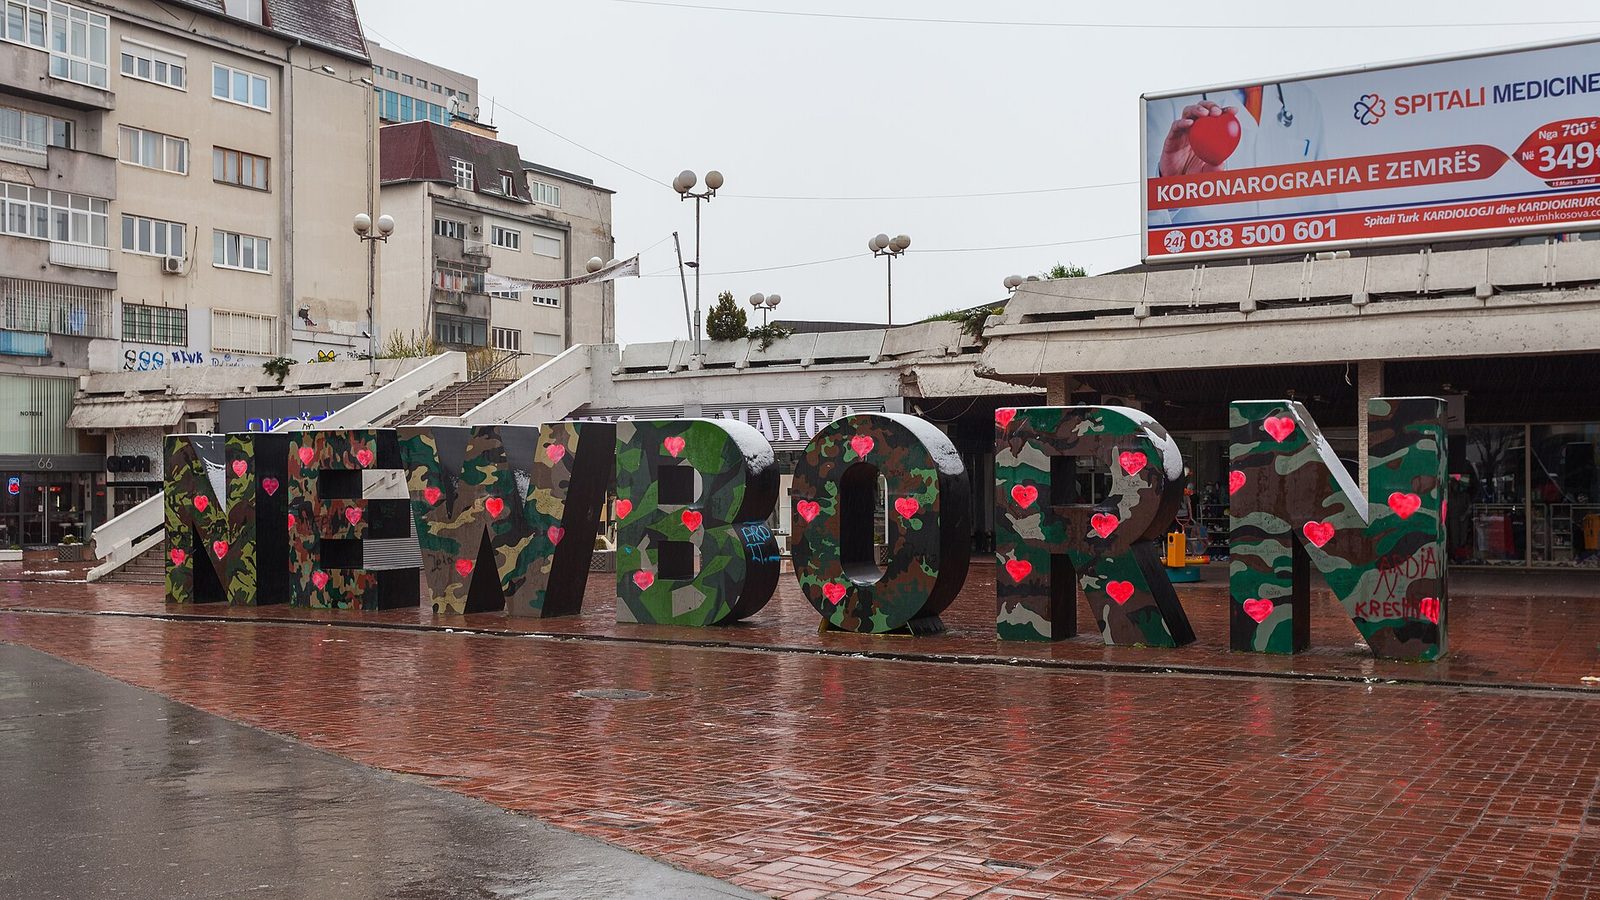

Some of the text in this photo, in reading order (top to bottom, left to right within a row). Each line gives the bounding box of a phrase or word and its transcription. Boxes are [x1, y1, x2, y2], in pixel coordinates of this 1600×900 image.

[1394, 73, 1600, 116] SPITALI MEDICINE
[1538, 130, 1558, 140] Nga
[1522, 151, 1534, 160] Në
[1157, 150, 1481, 202] KORONAROGRAFIA E ZEMRËS
[1364, 213, 1395, 228] Spitali
[1397, 212, 1420, 224] Turk
[1423, 206, 1495, 222] KARDIOLOGJI
[1496, 204, 1516, 215] dhe
[1190, 228, 1234, 249] 038
[1241, 224, 1285, 245] 500
[1293, 219, 1337, 241] 601
[38, 457, 52, 469] 66
[164, 396, 1449, 662] NEWBORN
